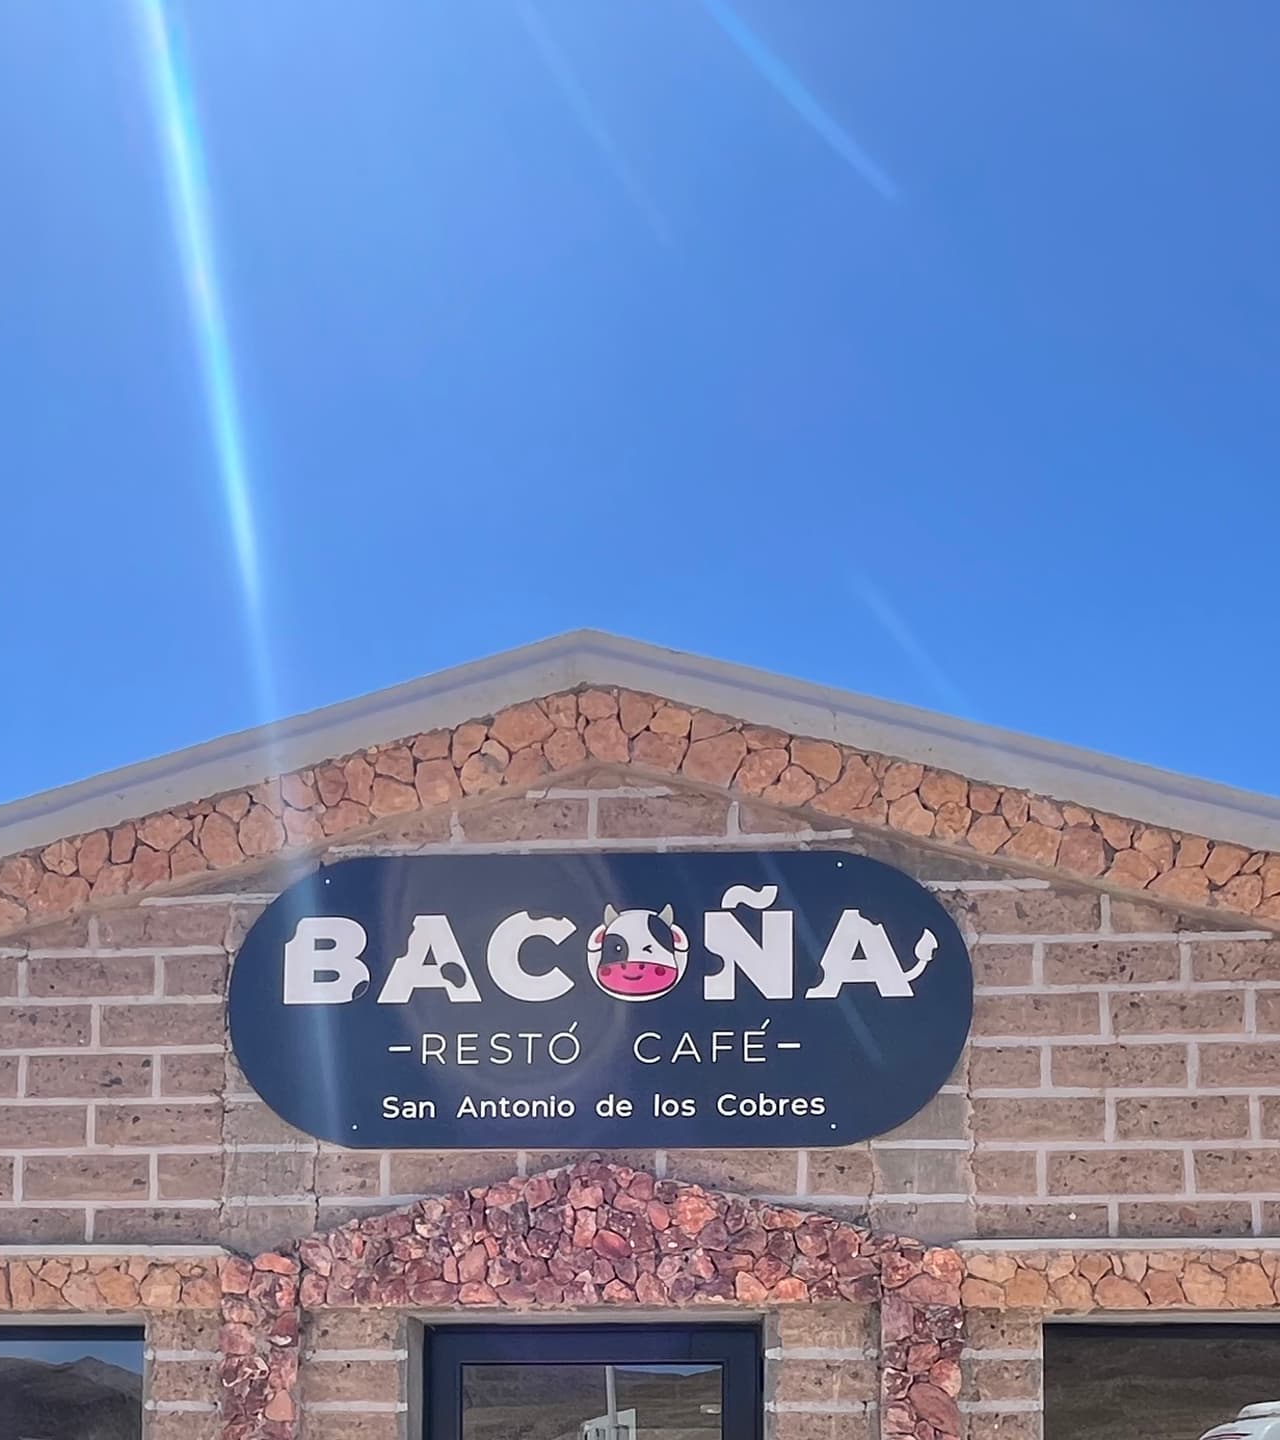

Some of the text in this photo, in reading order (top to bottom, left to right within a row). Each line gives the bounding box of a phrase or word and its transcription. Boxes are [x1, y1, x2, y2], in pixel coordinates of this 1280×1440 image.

[283, 883, 939, 1005] BACOÑA
[382, 1094, 826, 1120] San Antonio de los Cobres
